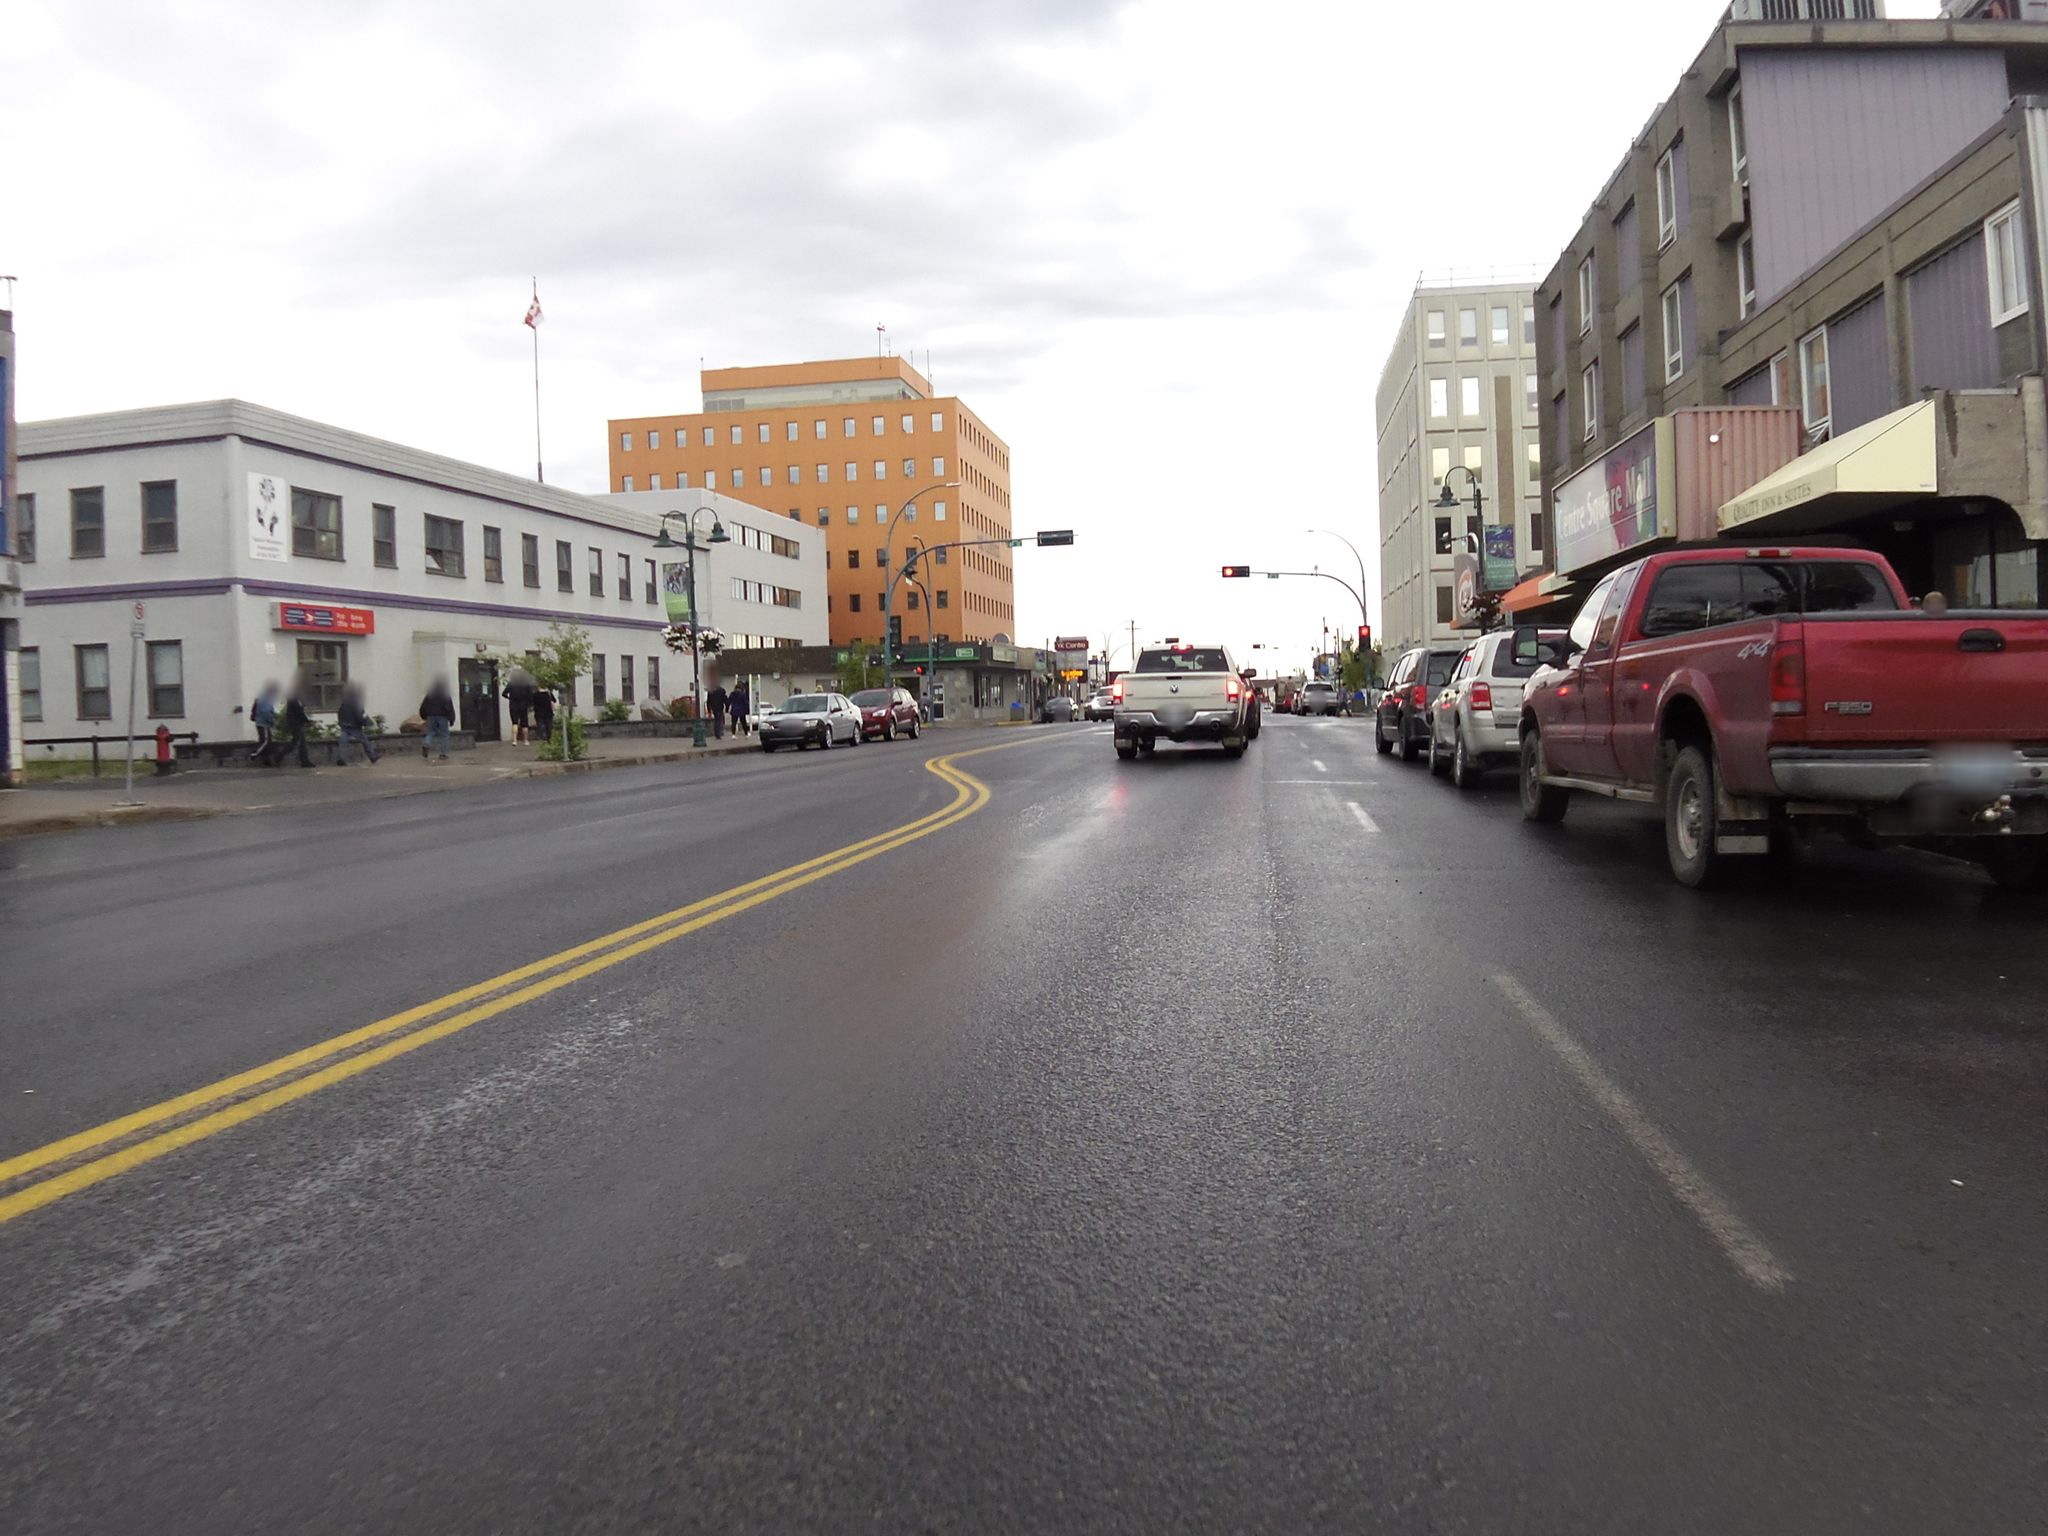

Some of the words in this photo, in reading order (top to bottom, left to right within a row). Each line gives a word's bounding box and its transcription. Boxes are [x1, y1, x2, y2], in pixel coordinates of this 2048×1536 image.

[1586, 485, 1624, 532] Square
[1625, 455, 1652, 508] Mall
[1733, 499, 1760, 523] QUALITY
[1785, 482, 1812, 502] SUITES
